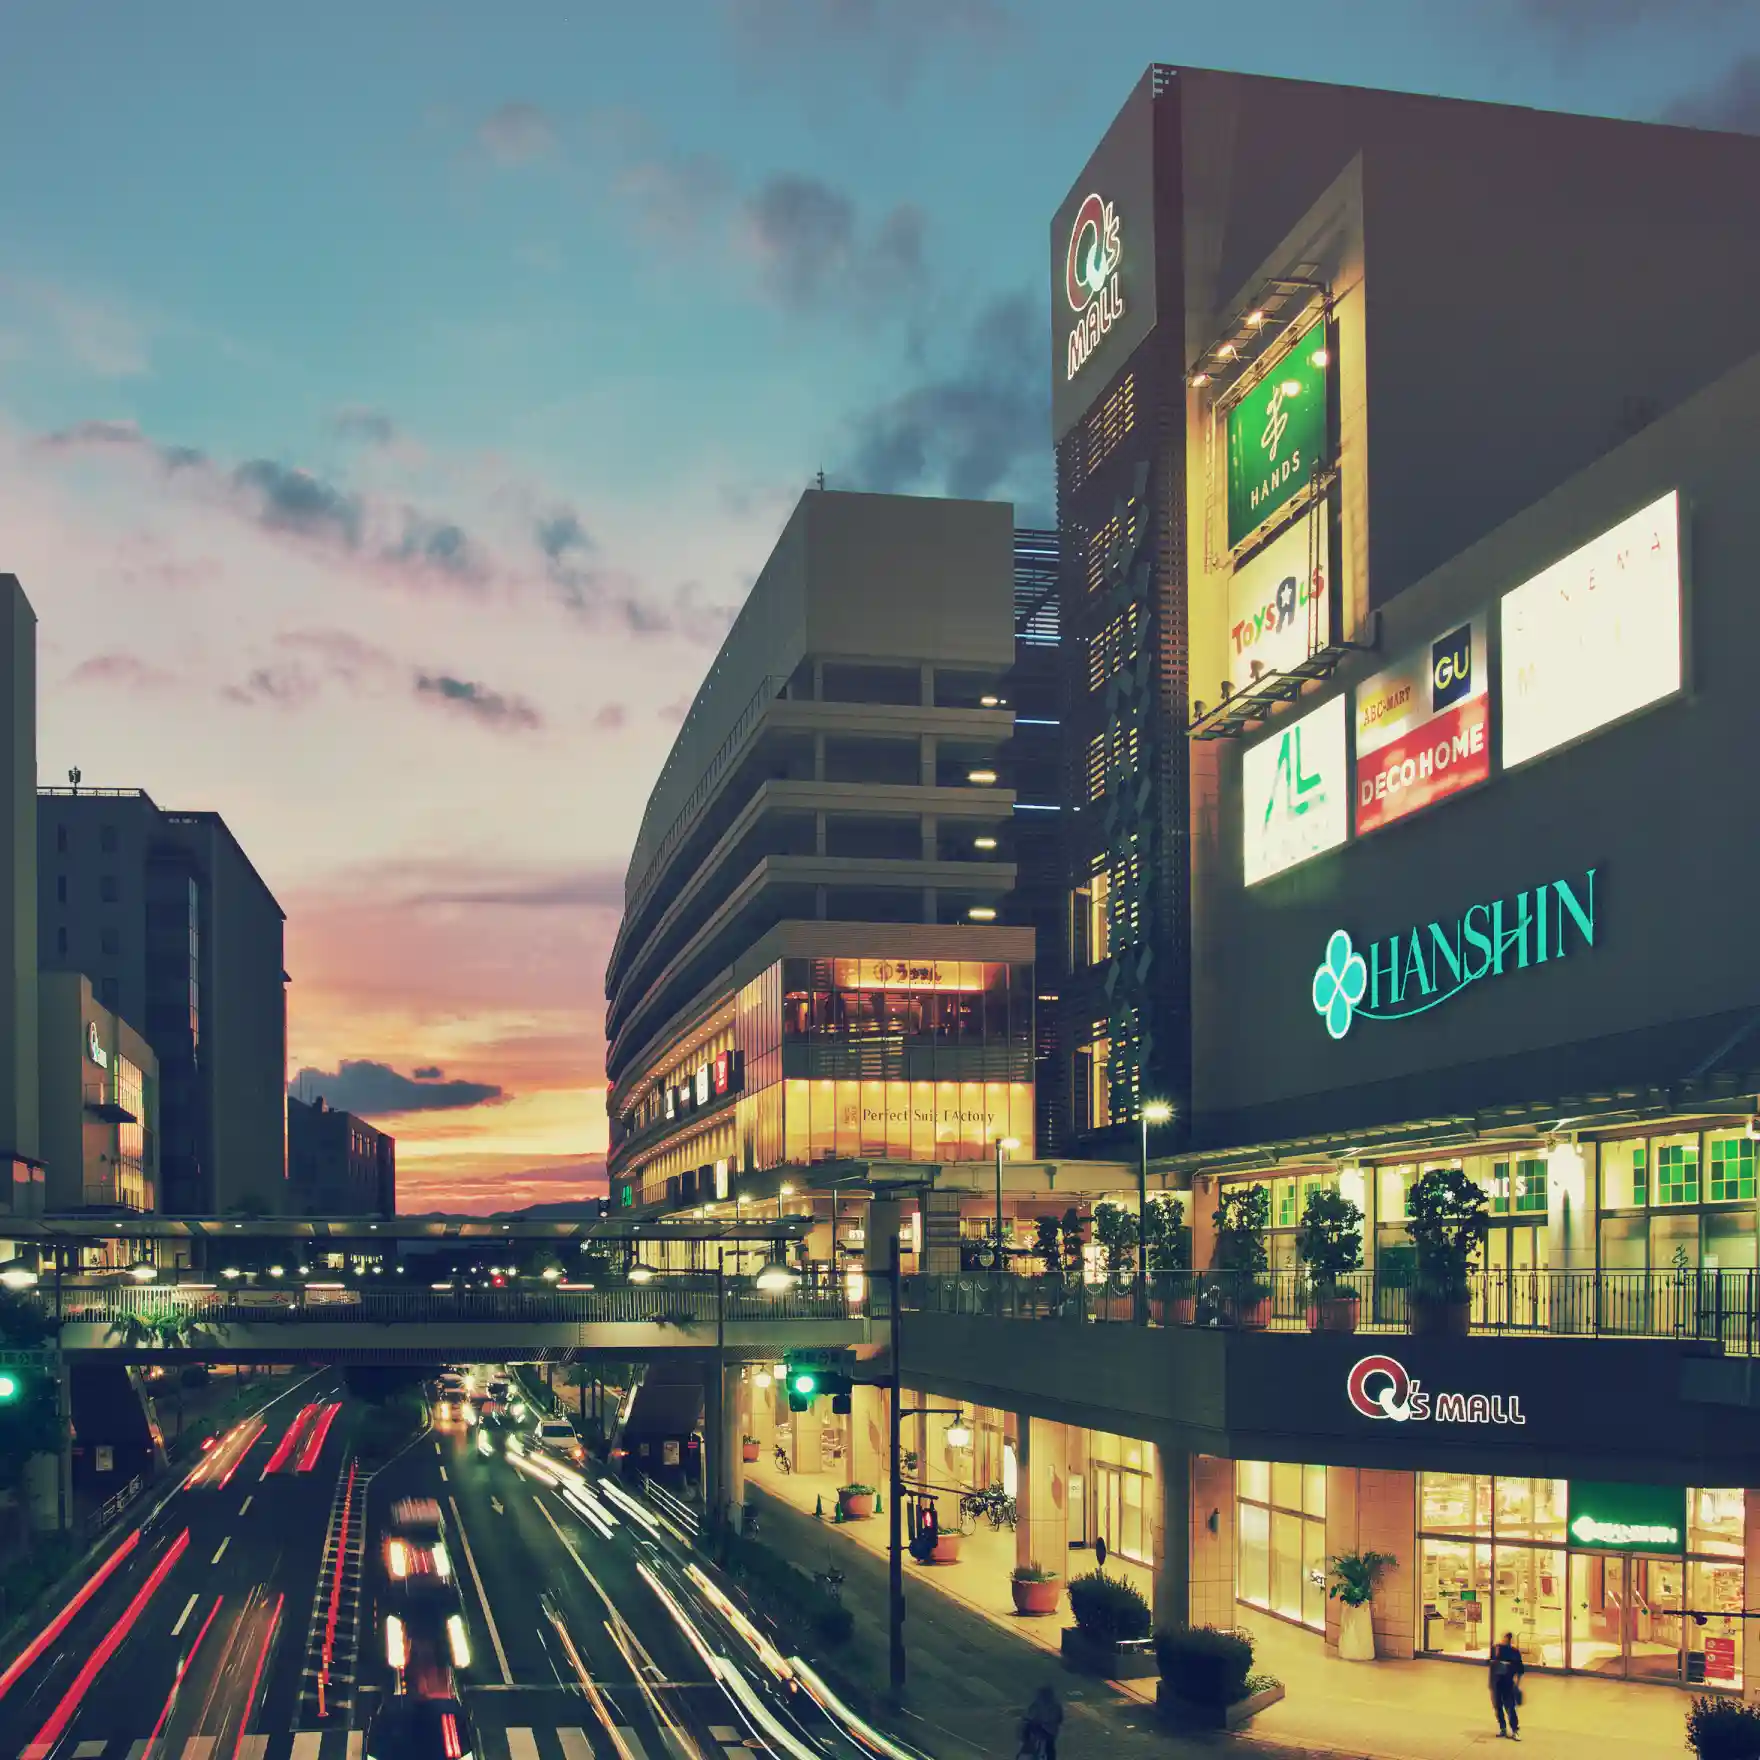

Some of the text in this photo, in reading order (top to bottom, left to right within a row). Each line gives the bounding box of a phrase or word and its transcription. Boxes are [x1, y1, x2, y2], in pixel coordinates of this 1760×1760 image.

[1067, 271, 1124, 381] MALL
[1250, 450, 1300, 510] HANDS
[1434, 645, 1470, 690] GU
[1369, 868, 1597, 1011] HANSHIN
[863, 1108, 908, 1122] Perfect
[1347, 1354, 1526, 1425] Q's MALL
